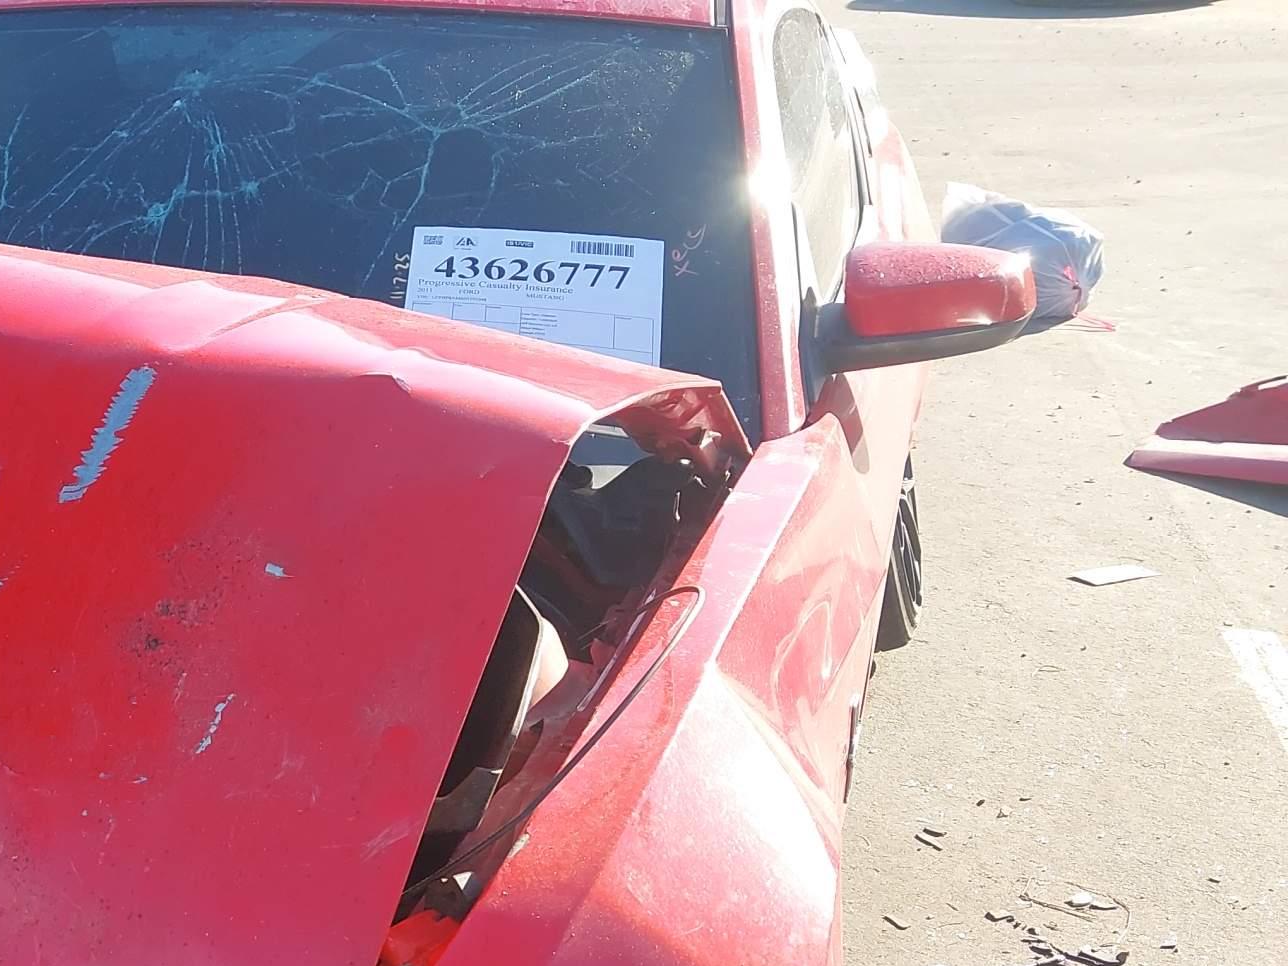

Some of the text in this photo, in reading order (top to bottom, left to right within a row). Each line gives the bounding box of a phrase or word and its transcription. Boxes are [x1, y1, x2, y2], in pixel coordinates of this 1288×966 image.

[433, 255, 631, 289] 43626777
[418, 279, 574, 294] Progressive Casualty Insurance
[526, 293, 565, 301] MUSTANG
